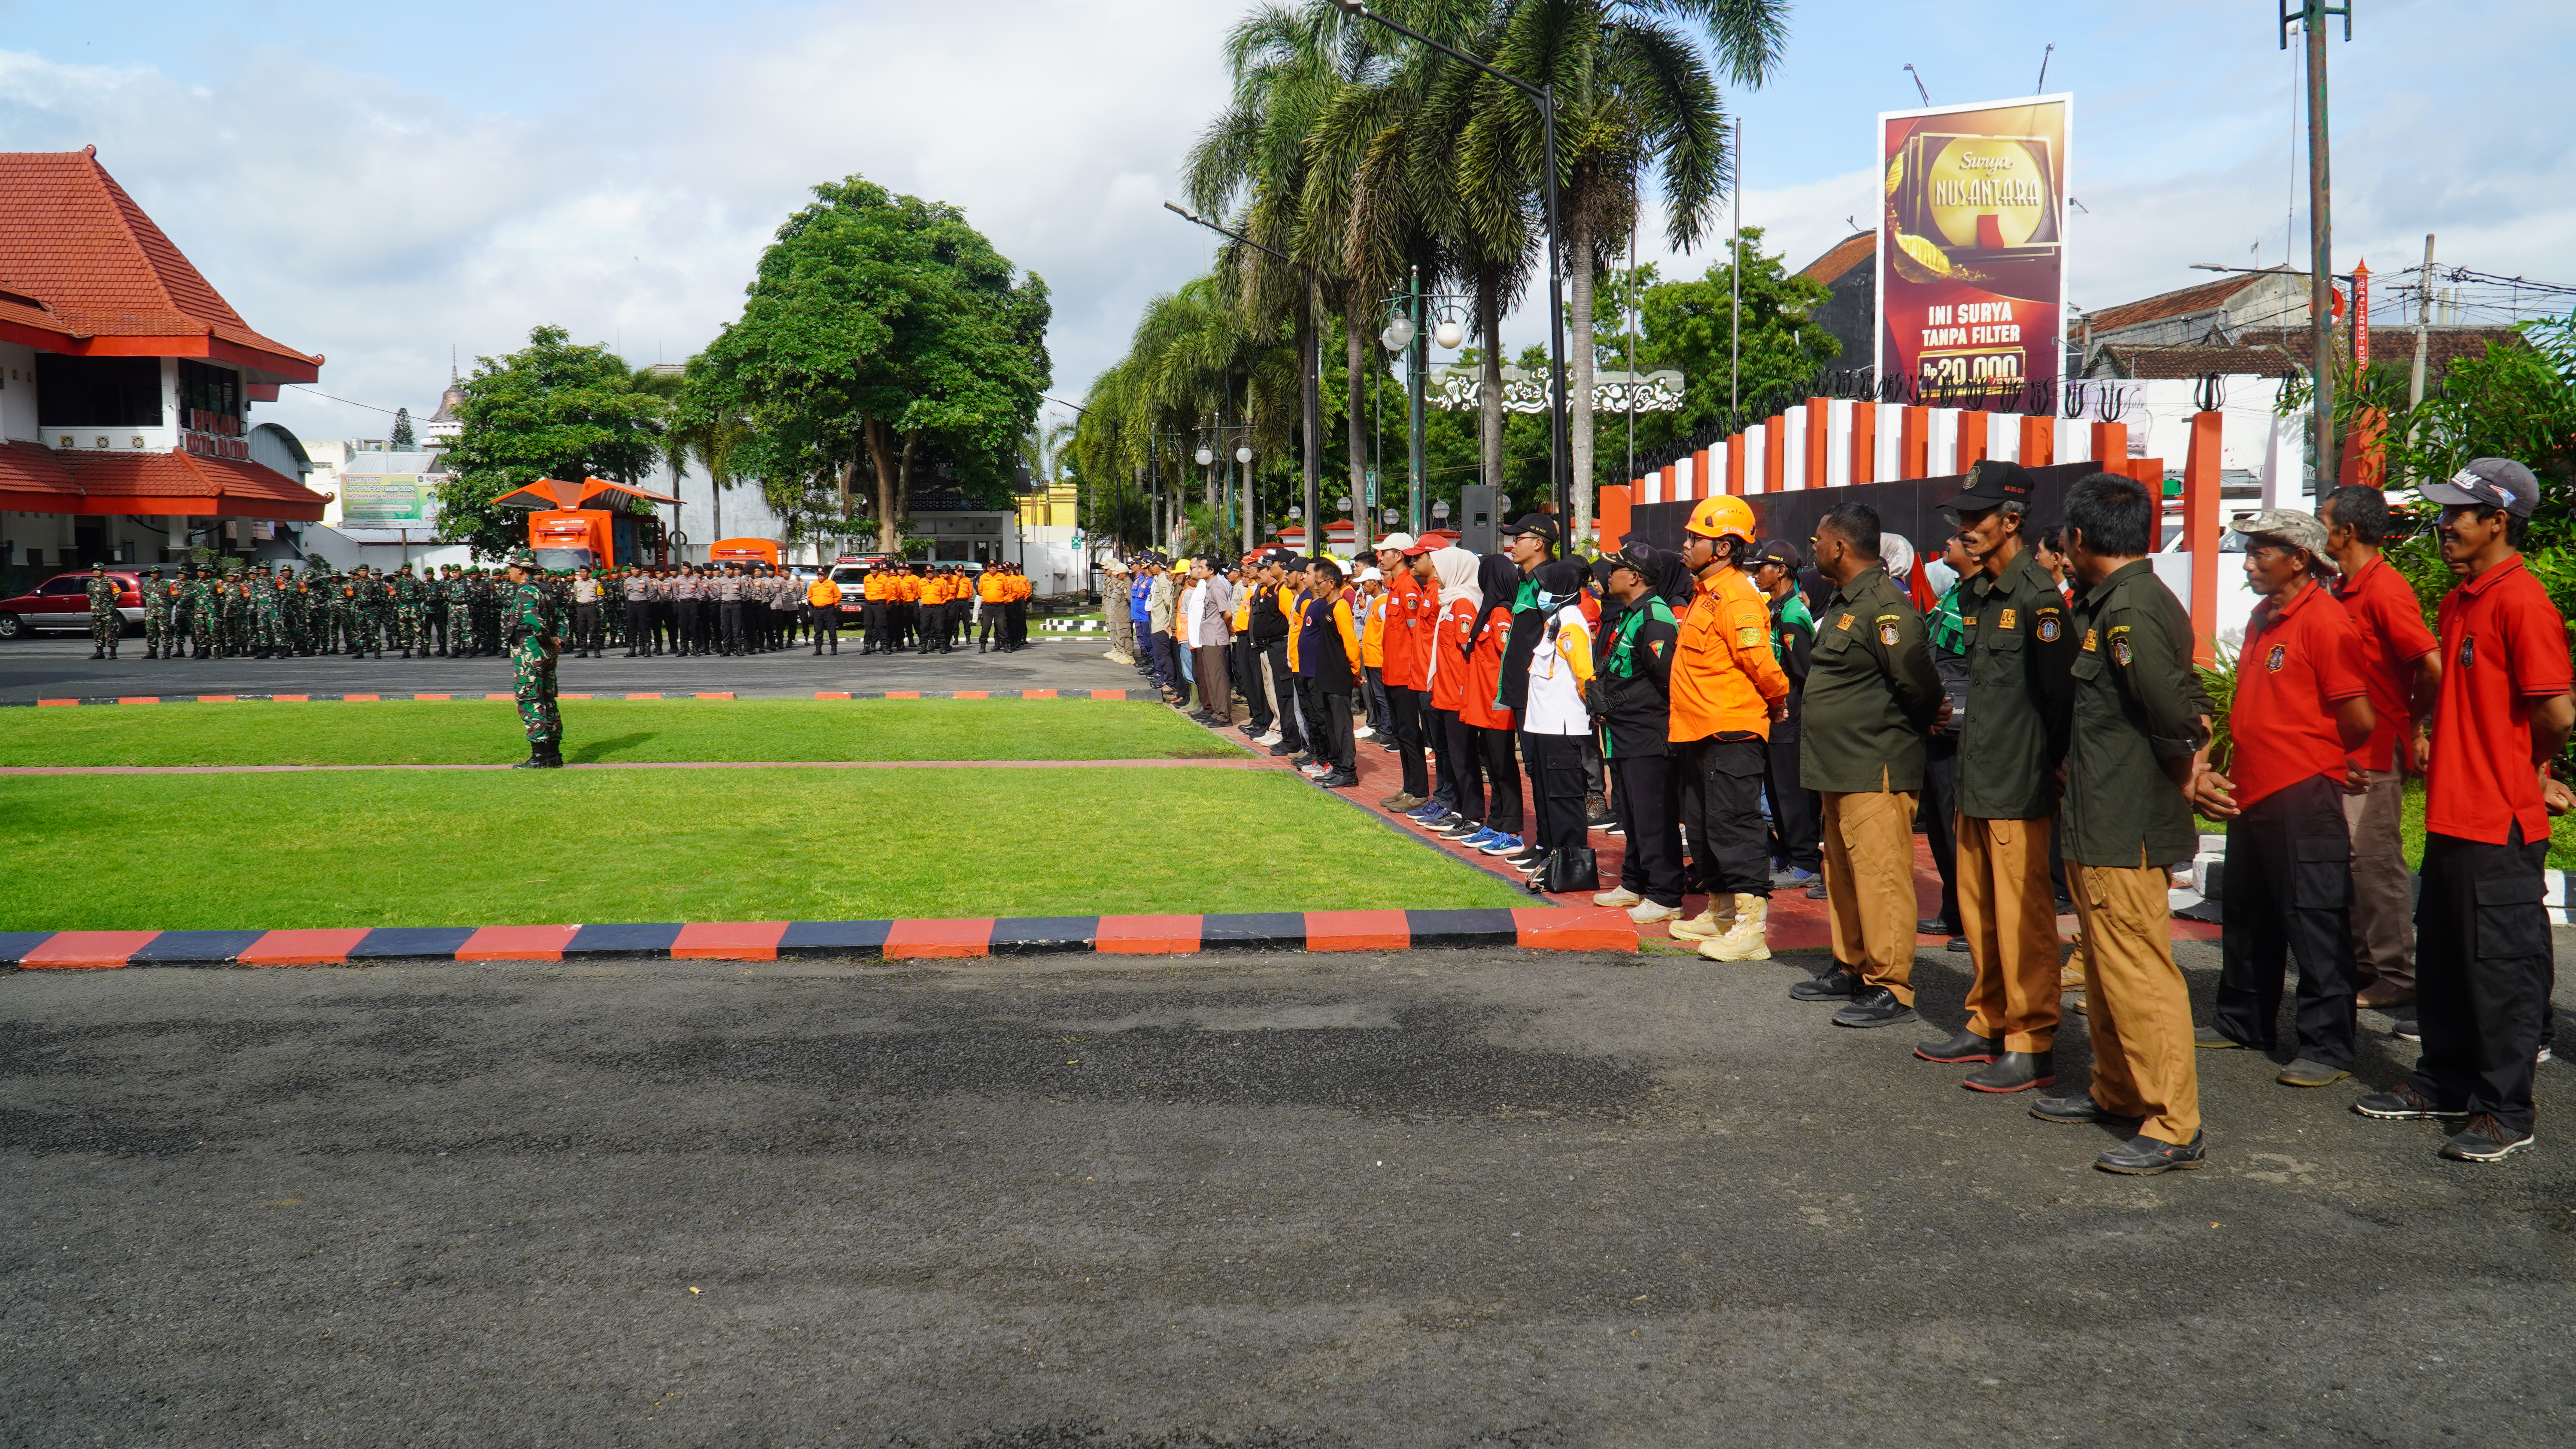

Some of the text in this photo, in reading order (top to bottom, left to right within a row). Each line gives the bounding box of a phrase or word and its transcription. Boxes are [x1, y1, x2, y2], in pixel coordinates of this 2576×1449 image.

[1959, 152, 2014, 176] Surya
[1935, 179, 2039, 206] NUSANTARA
[1929, 301, 2013, 326] INI SURYA
[1922, 324, 2020, 347] TANPA FILTER
[191, 408, 239, 436] BPKAD
[184, 433, 250, 459] KOTA BLITAR
